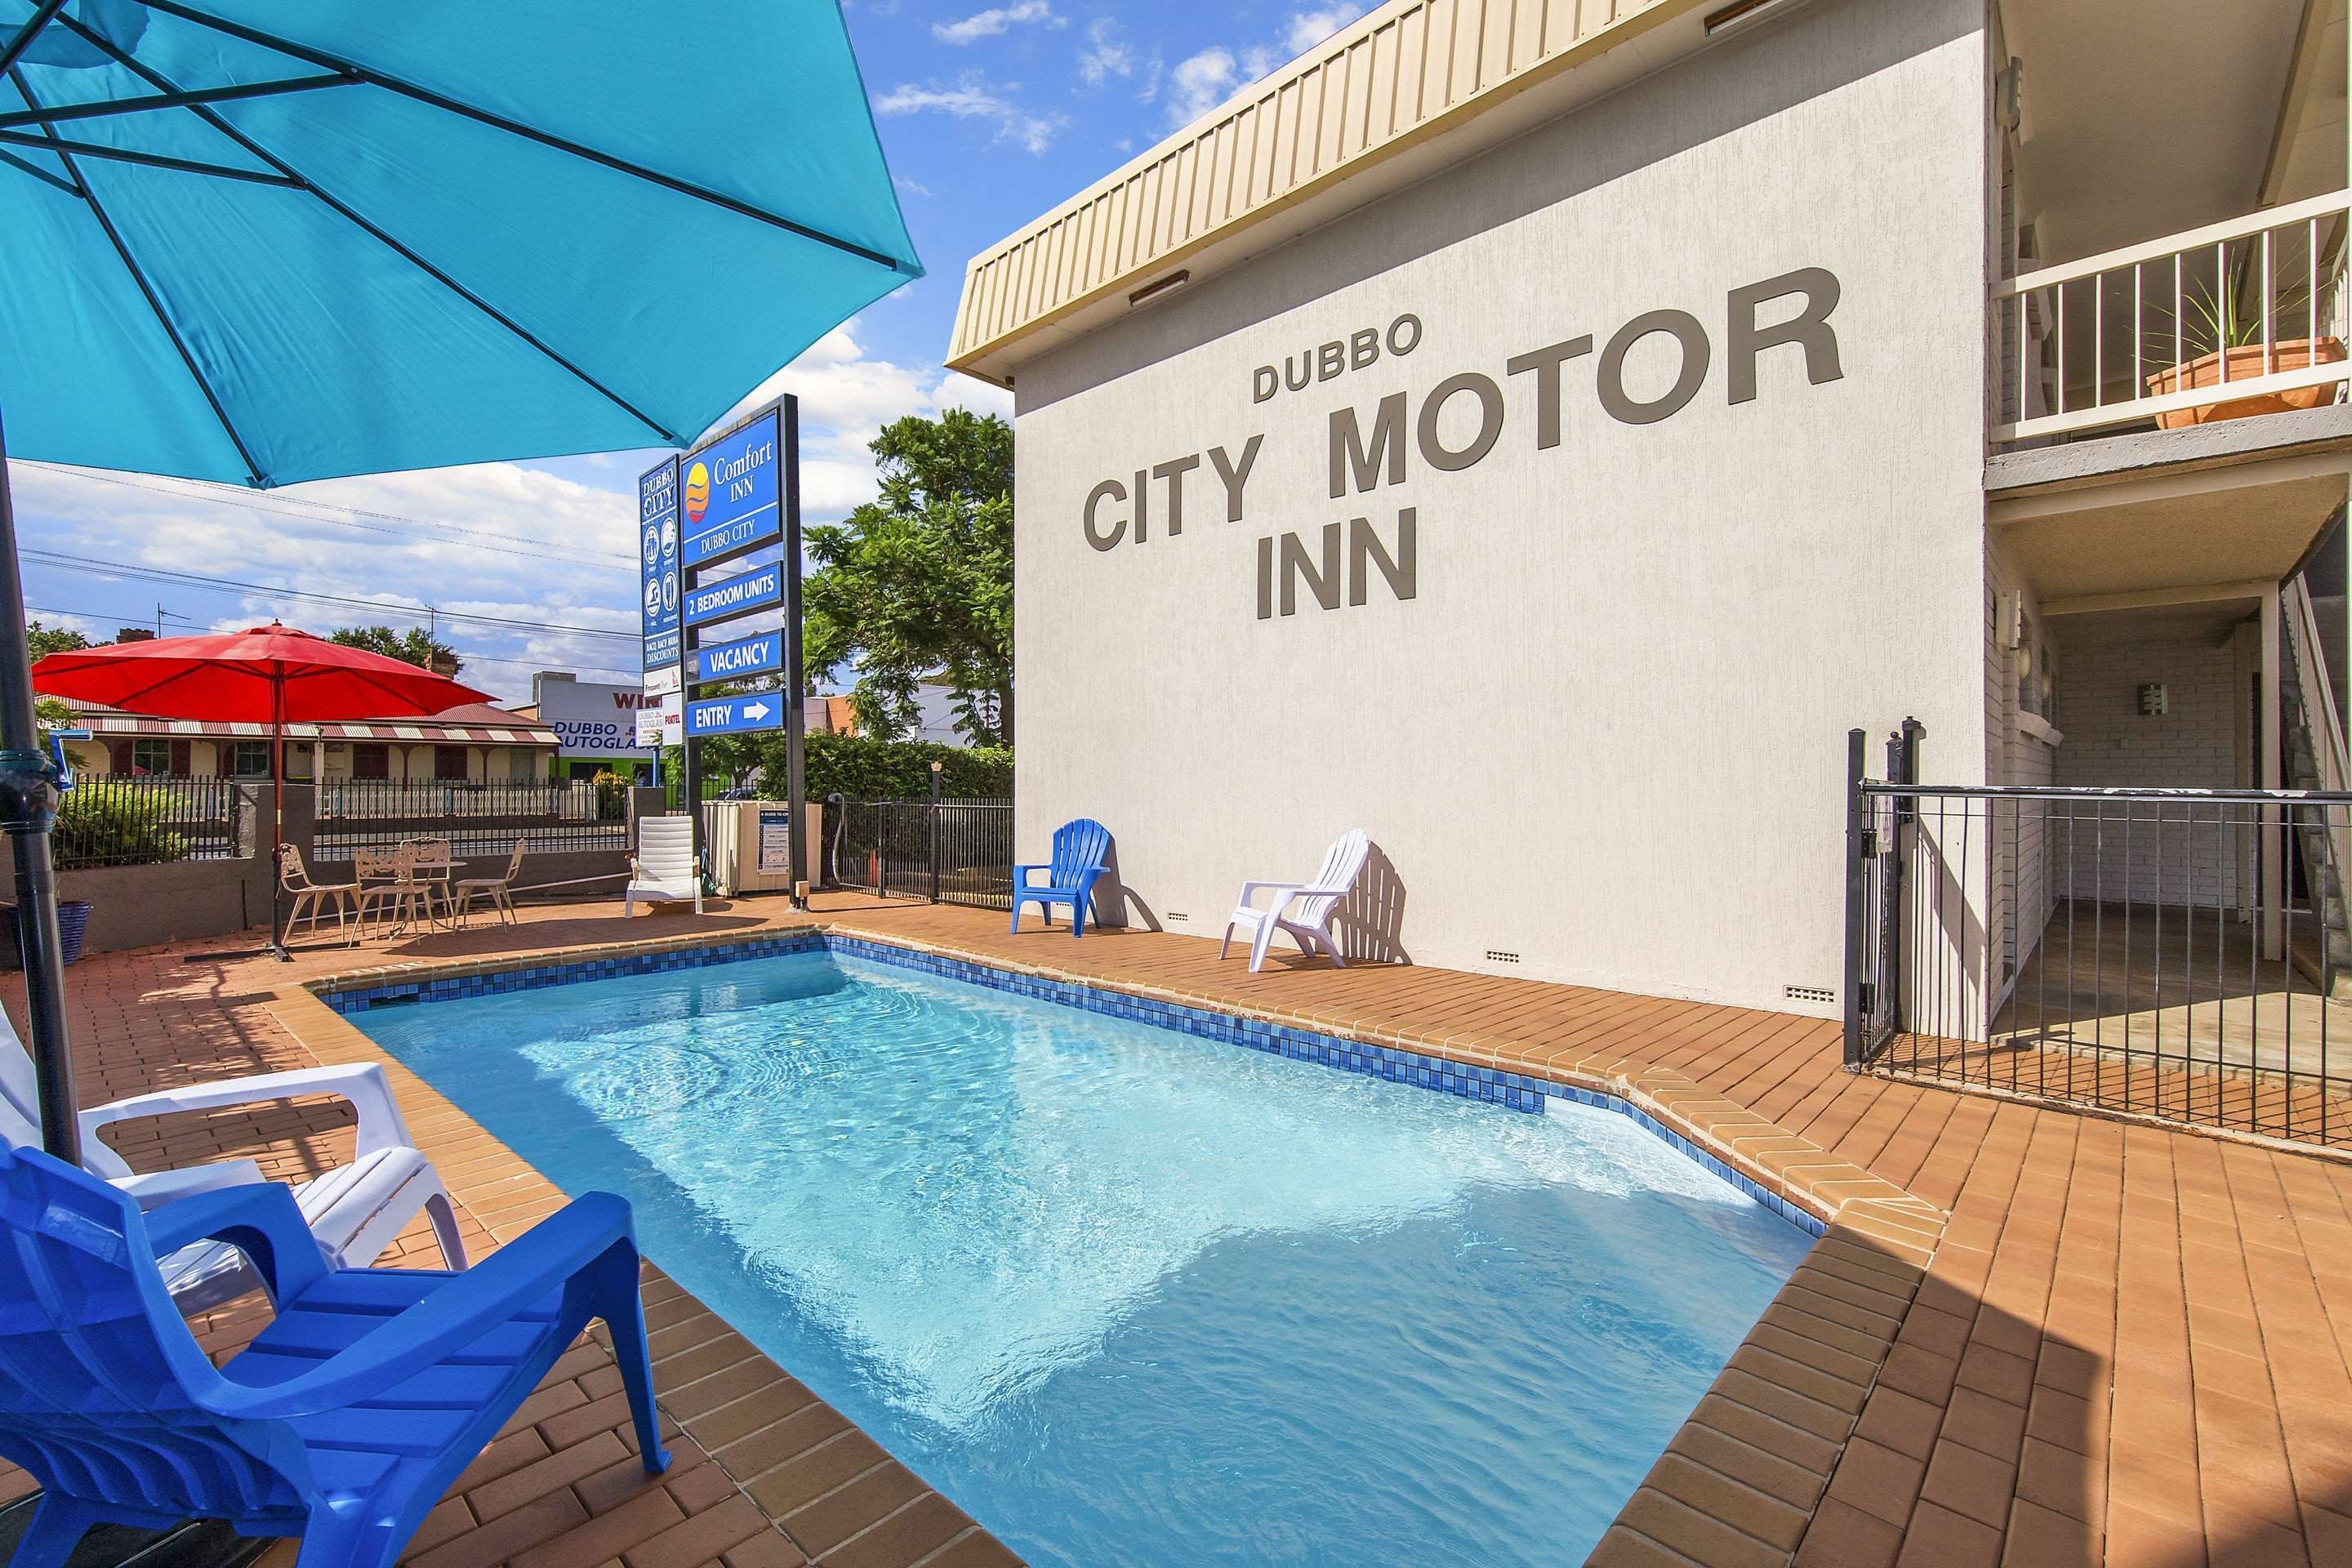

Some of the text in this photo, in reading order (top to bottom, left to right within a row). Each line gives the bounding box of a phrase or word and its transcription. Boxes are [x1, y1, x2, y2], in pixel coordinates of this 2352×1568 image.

[1253, 313, 1423, 404] DUBBO
[1083, 266, 1845, 552] CITY MOTOR
[714, 440, 772, 485] Comfort
[643, 467, 674, 497] DUBBO
[730, 474, 754, 503] INN
[644, 483, 675, 517] CITY
[701, 519, 755, 555] DUBBO CITY
[1257, 506, 1417, 620] INN
[688, 574, 774, 615] 2 BEDROOM UNITS
[646, 646, 679, 664] DISCOUNTS
[710, 640, 769, 673] VACANCY
[613, 693, 663, 710] WIN
[696, 705, 732, 728] ENTRY
[554, 721, 617, 735] DUBBO
[665, 715, 680, 725] FOXTEL
[557, 735, 653, 750] AUTOGLA
